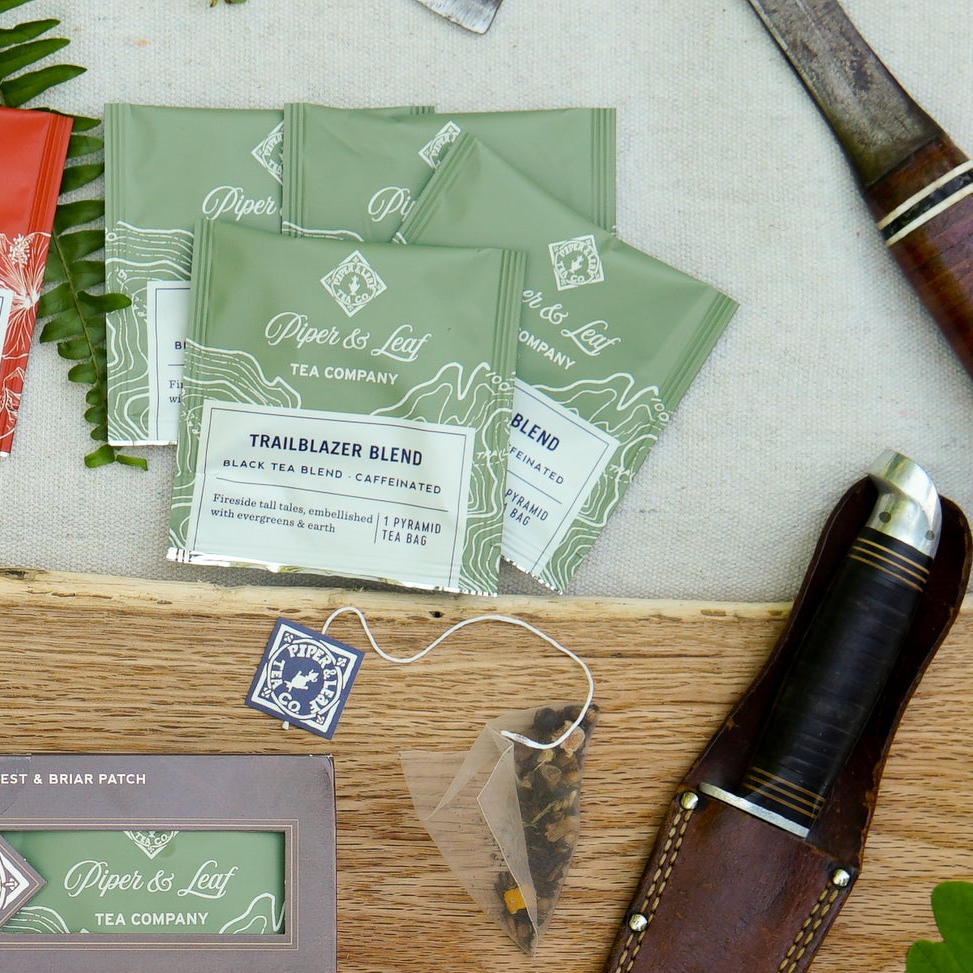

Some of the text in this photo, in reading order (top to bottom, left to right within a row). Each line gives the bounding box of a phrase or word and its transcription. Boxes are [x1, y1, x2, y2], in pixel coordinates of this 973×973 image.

[265, 312, 432, 362] Piper & Leaf
[291, 364, 398, 384] TEA COMPANY
[250, 434, 422, 465] TRAILBLAZER BLEND
[223, 460, 441, 494] BLACK TEA BLEND CAFFEINATED
[211, 509, 335, 533] with evergreens & earth
[213, 494, 372, 523] Fireside tall tales, embellished
[34, 774, 42, 784] &
[50, 774, 93, 784] BRIAR
[99, 774, 145, 784] PATCH
[64, 859, 238, 898] Piper & Leaf
[95, 912, 208, 925] TEA COMPANY
